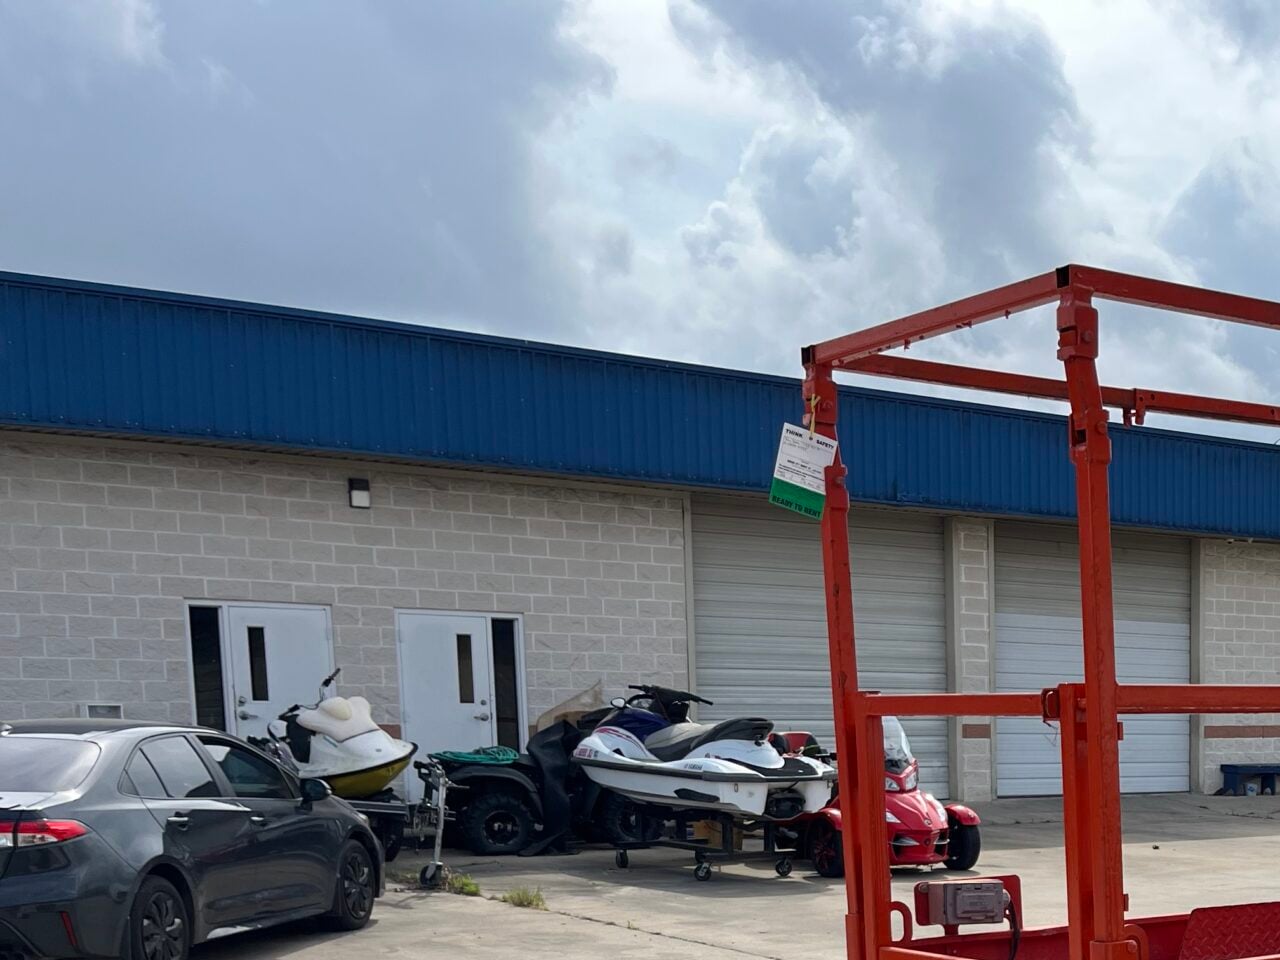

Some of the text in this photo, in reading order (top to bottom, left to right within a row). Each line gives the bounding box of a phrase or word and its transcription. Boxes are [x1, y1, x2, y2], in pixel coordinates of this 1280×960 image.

[786, 429, 803, 438] THINK
[816, 439, 834, 450] SAFETY
[772, 495, 793, 507] READY
[794, 502, 803, 512] TO
